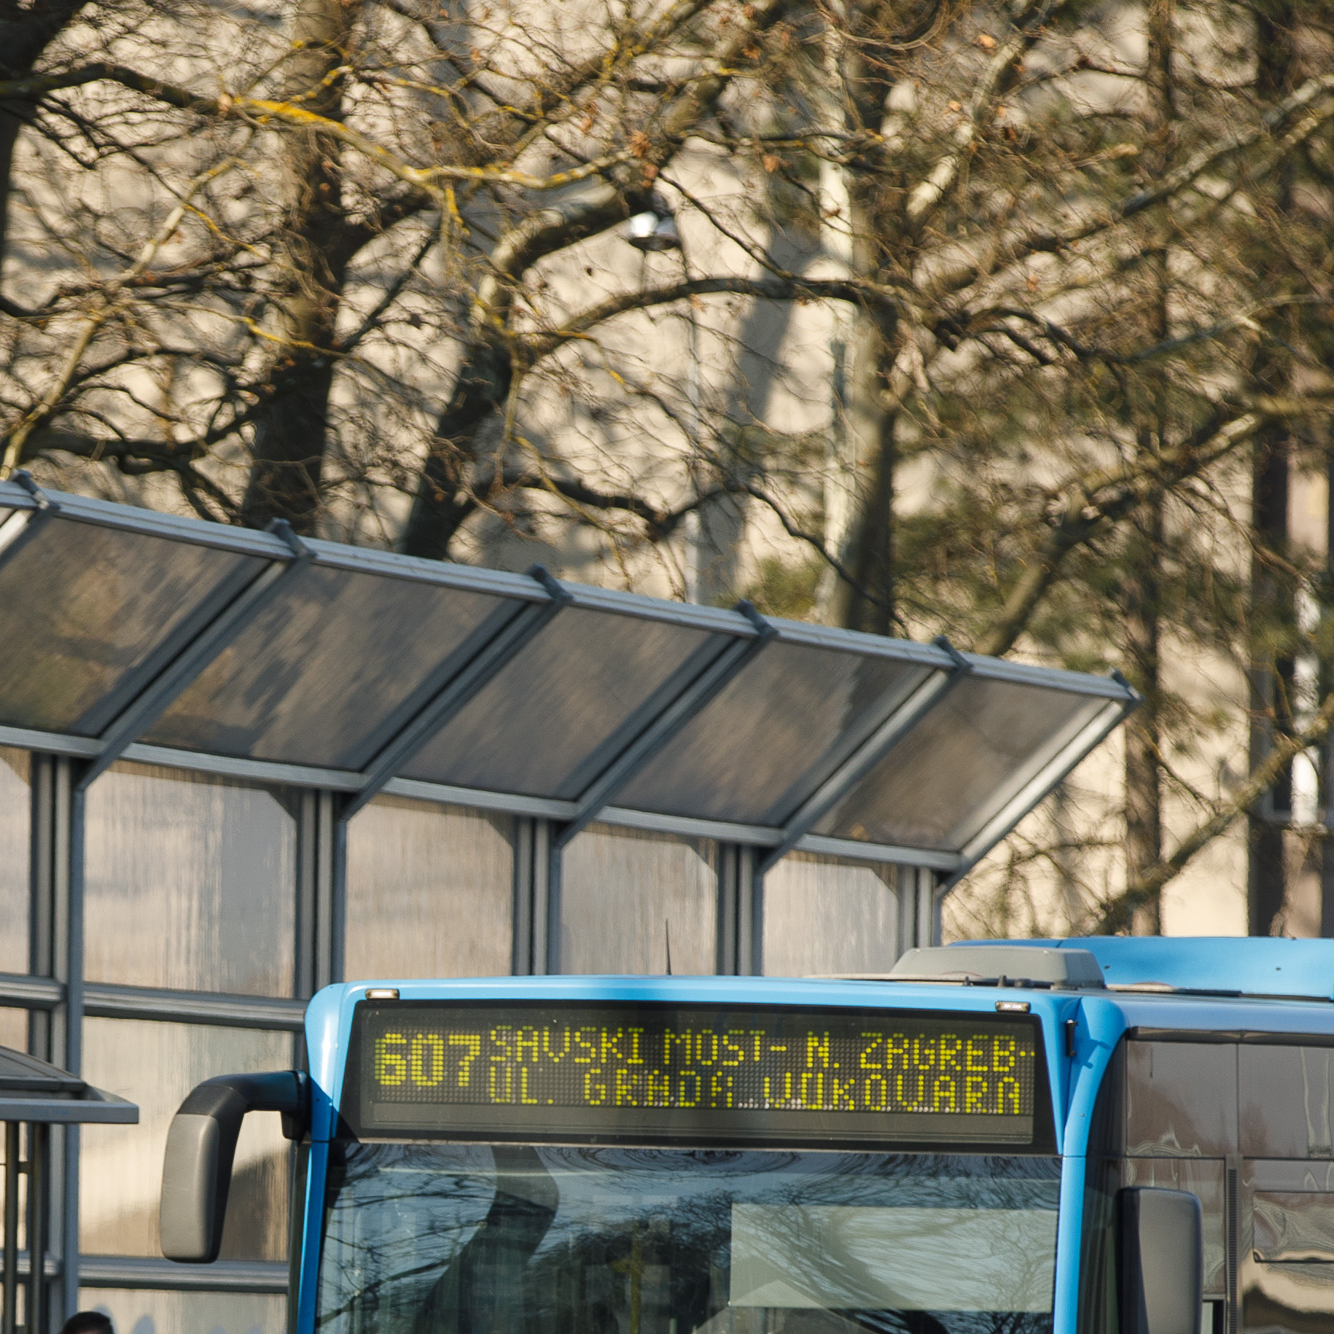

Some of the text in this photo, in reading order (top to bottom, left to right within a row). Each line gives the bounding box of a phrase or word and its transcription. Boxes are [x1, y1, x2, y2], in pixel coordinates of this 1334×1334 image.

[374, 1032, 481, 1087] 607
[490, 1025, 644, 1064] SAVSKI
[807, 1031, 840, 1068] N.
[490, 1066, 554, 1104] UL.
[584, 1068, 733, 1109] GRADA
